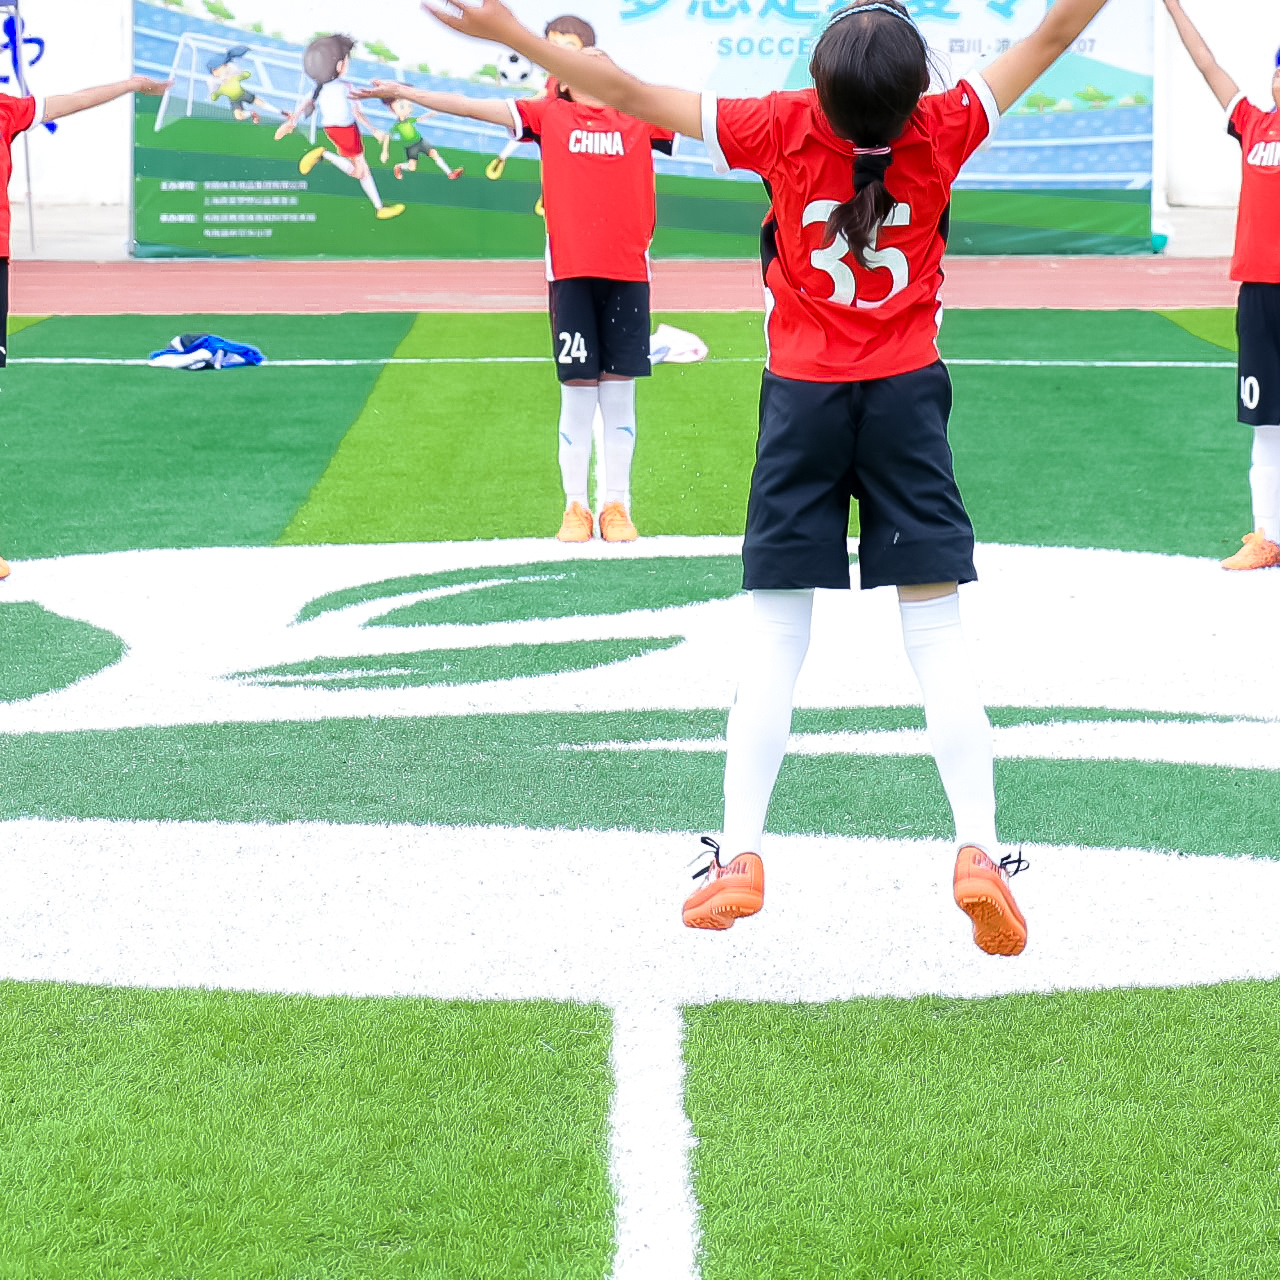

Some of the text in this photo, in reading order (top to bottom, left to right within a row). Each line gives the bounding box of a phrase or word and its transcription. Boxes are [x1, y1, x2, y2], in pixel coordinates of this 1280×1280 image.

[717, 37, 813, 56] SOCCE
[568, 129, 625, 155] CHINA
[802, 199, 911, 308] 35
[558, 331, 588, 364] 24
